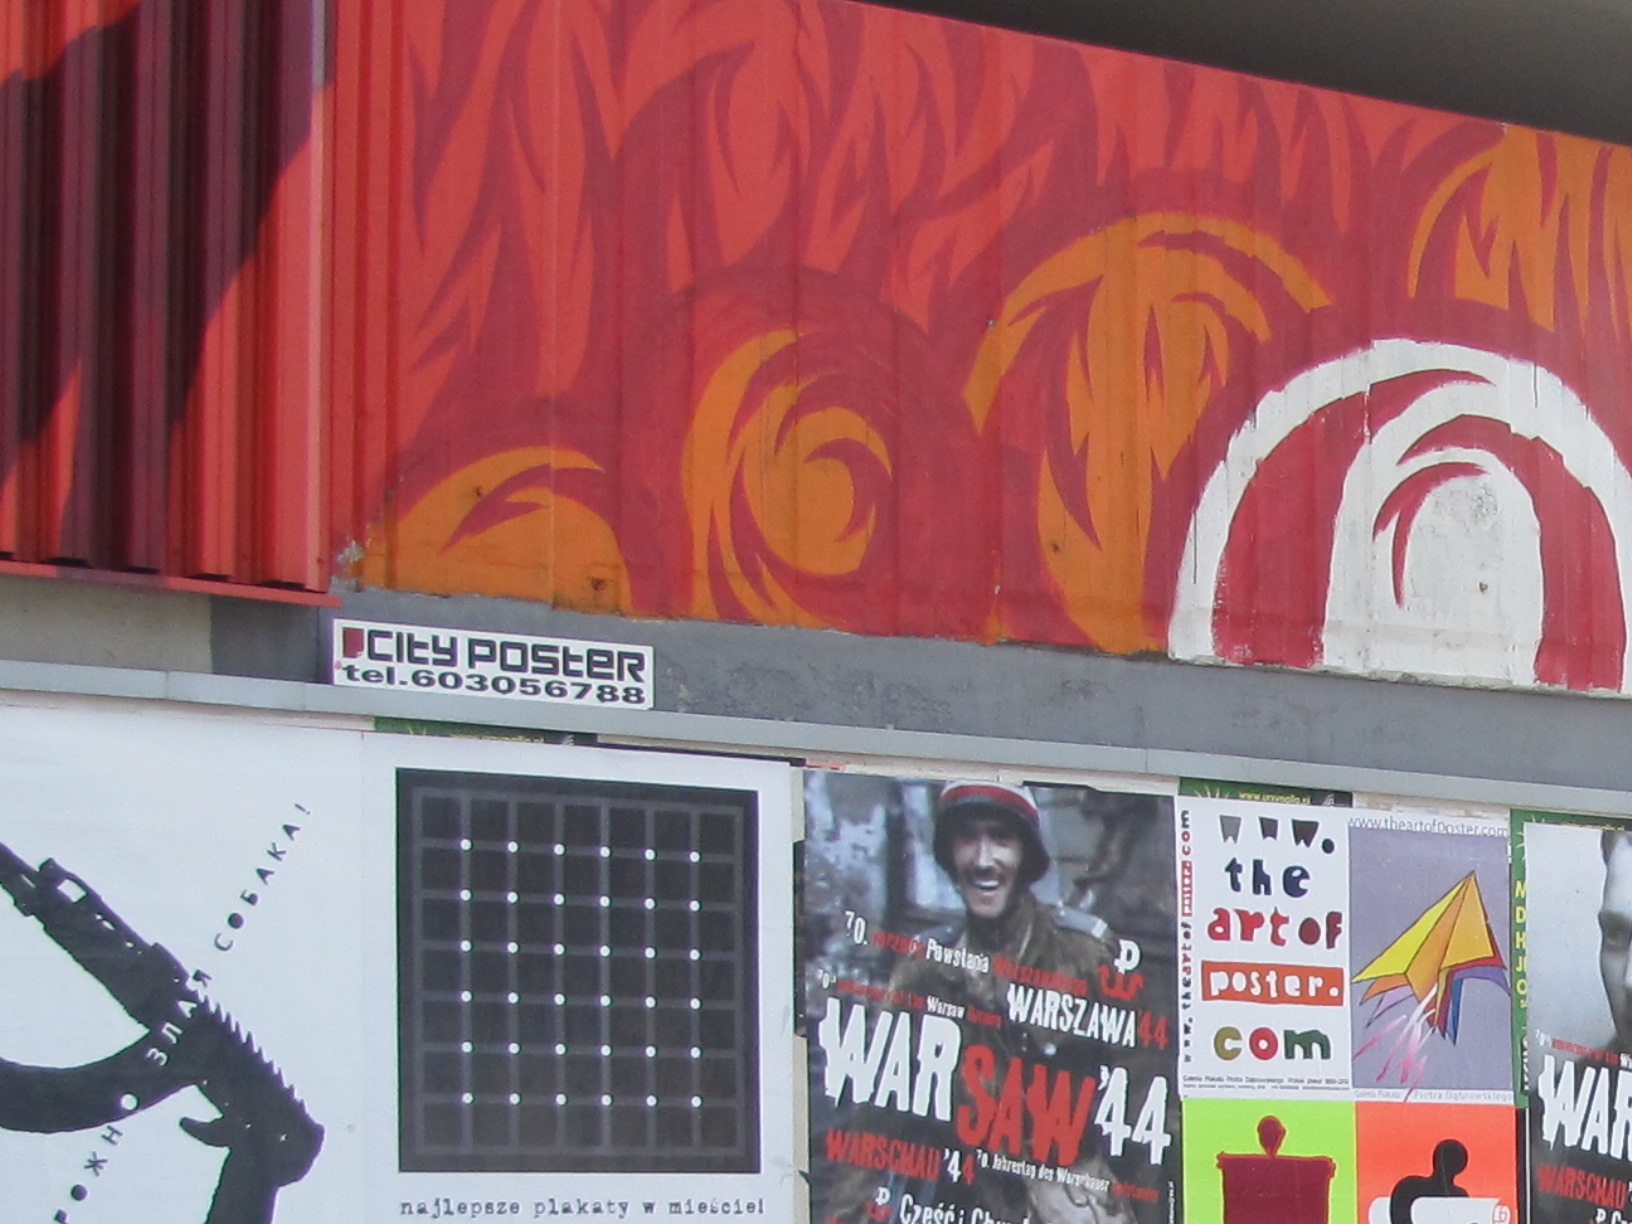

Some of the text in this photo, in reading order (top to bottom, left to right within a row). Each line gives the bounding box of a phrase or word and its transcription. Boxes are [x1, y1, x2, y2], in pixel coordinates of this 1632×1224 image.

[342, 662, 646, 706] tel.603056788
[1219, 814, 1336, 855] www.
[1224, 856, 1311, 899] the
[1209, 969, 1340, 999] poster.
[1007, 983, 1135, 1048] WARSZAWA
[1213, 1026, 1332, 1061] com
[825, 1128, 940, 1181] WARSCHAU
[400, 1198, 520, 1219] najlepsze
[533, 1198, 630, 1219] plakaty
[643, 1200, 656, 1215] w
[1538, 1164, 1628, 1210] WARSCHAU
